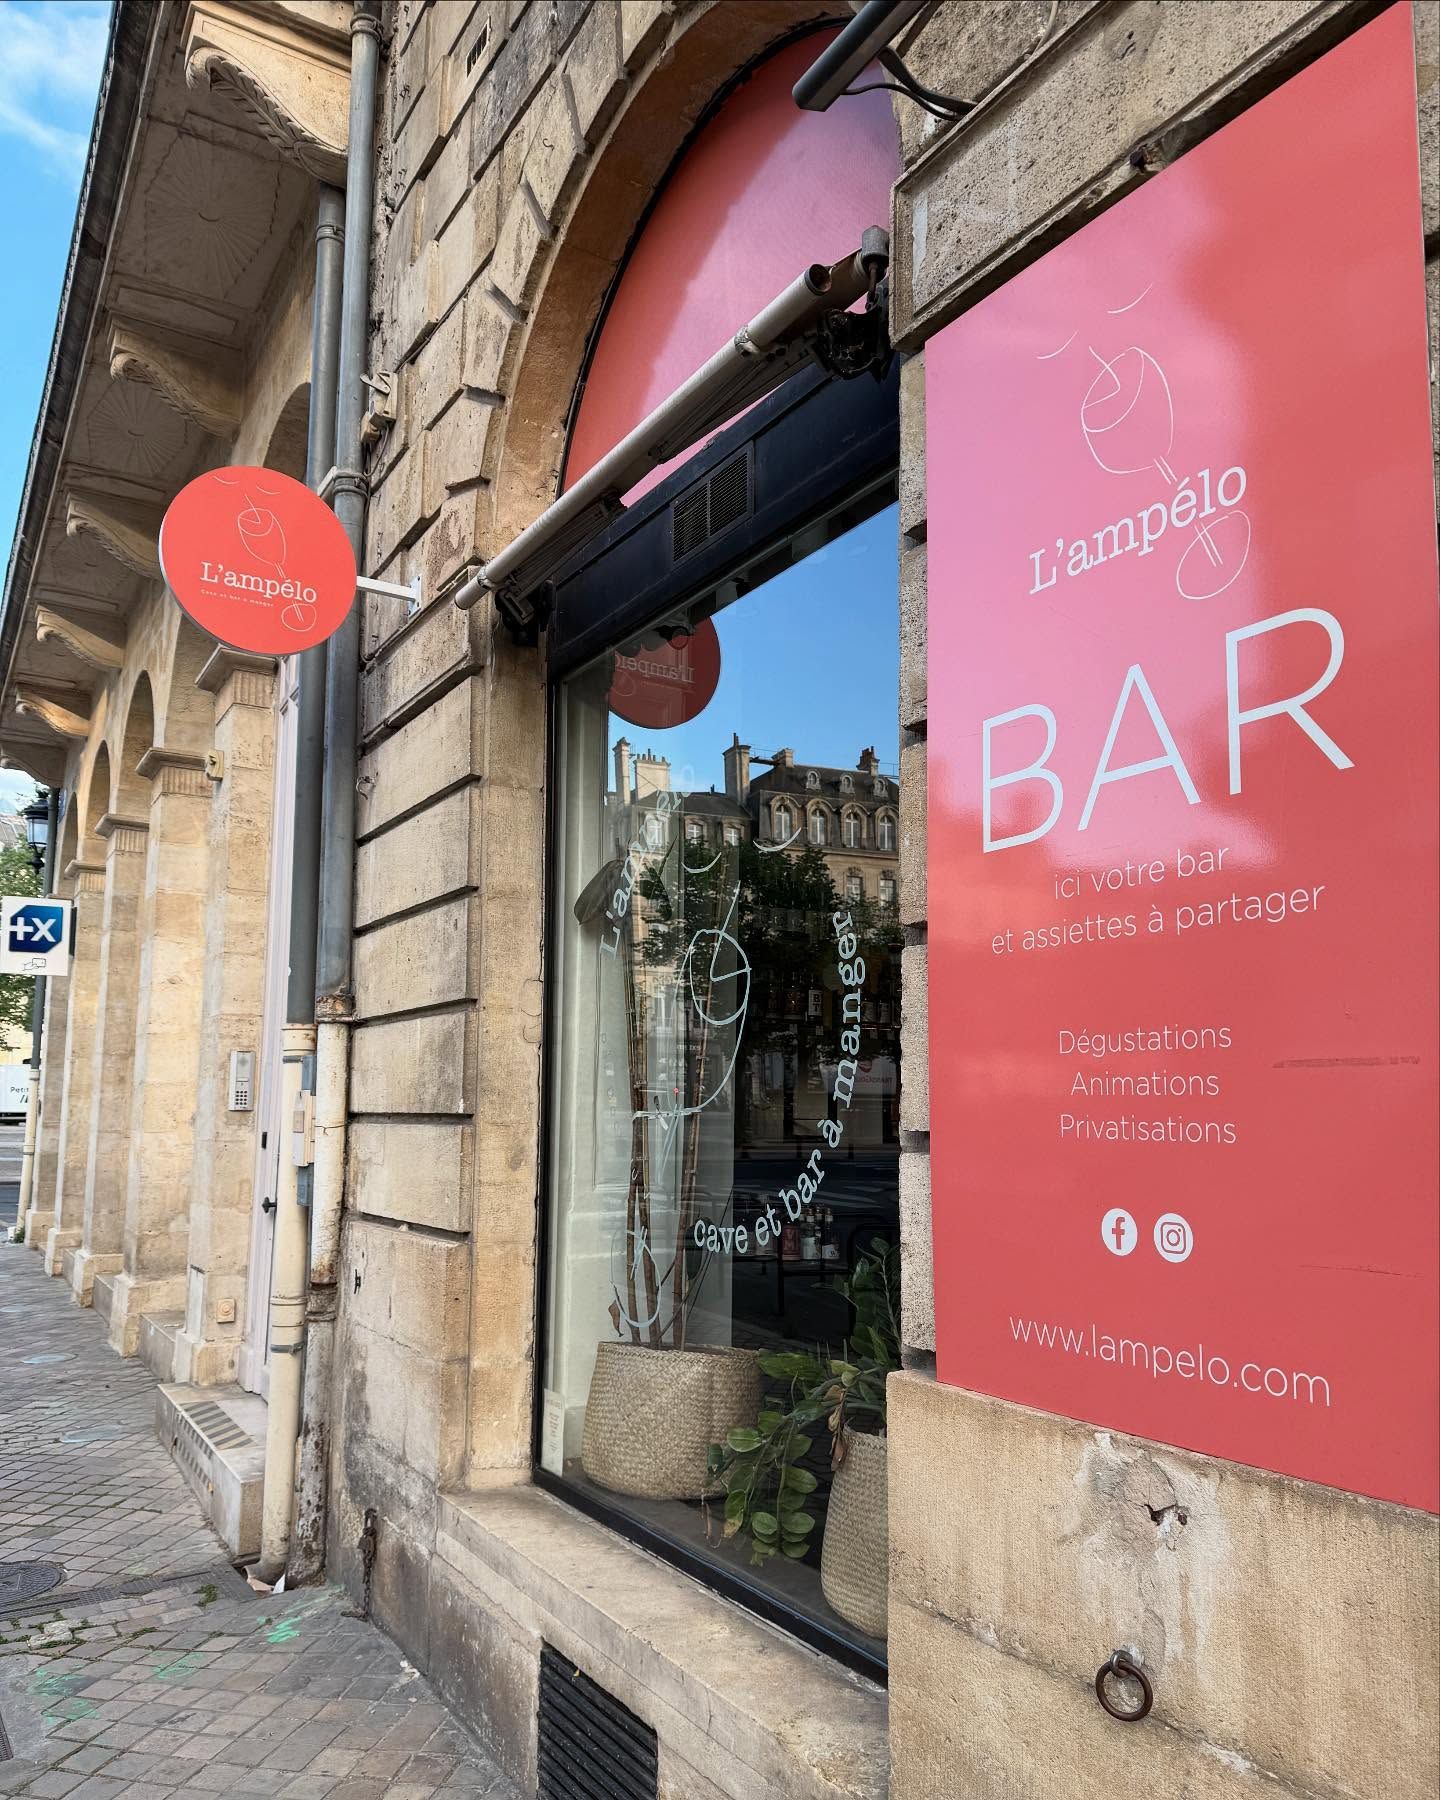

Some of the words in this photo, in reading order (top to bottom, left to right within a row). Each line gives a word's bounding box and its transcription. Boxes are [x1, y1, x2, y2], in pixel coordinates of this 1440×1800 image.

[1029, 466, 1247, 595] L'ampélo
[199, 561, 318, 604] L'ampélo
[982, 606, 1356, 854] BAR
[1055, 869, 1080, 900] ici
[1090, 860, 1165, 893] votre
[1177, 847, 1230, 878] bar
[991, 929, 1014, 955] et
[1022, 913, 1137, 951] assiettes
[1147, 904, 1165, 933] à
[1176, 884, 1326, 936] partager
[1059, 1024, 1232, 1059] Dégustations
[694, 1219, 748, 1254] cave
[756, 1204, 782, 1246] et
[779, 1149, 825, 1221] bar
[816, 1118, 844, 1149] à
[832, 910, 867, 1108] manger
[1070, 1069, 1220, 1097] Animations
[1060, 1113, 1237, 1144] Privatisations
[1009, 1316, 1331, 1407] www.lampelo.com
